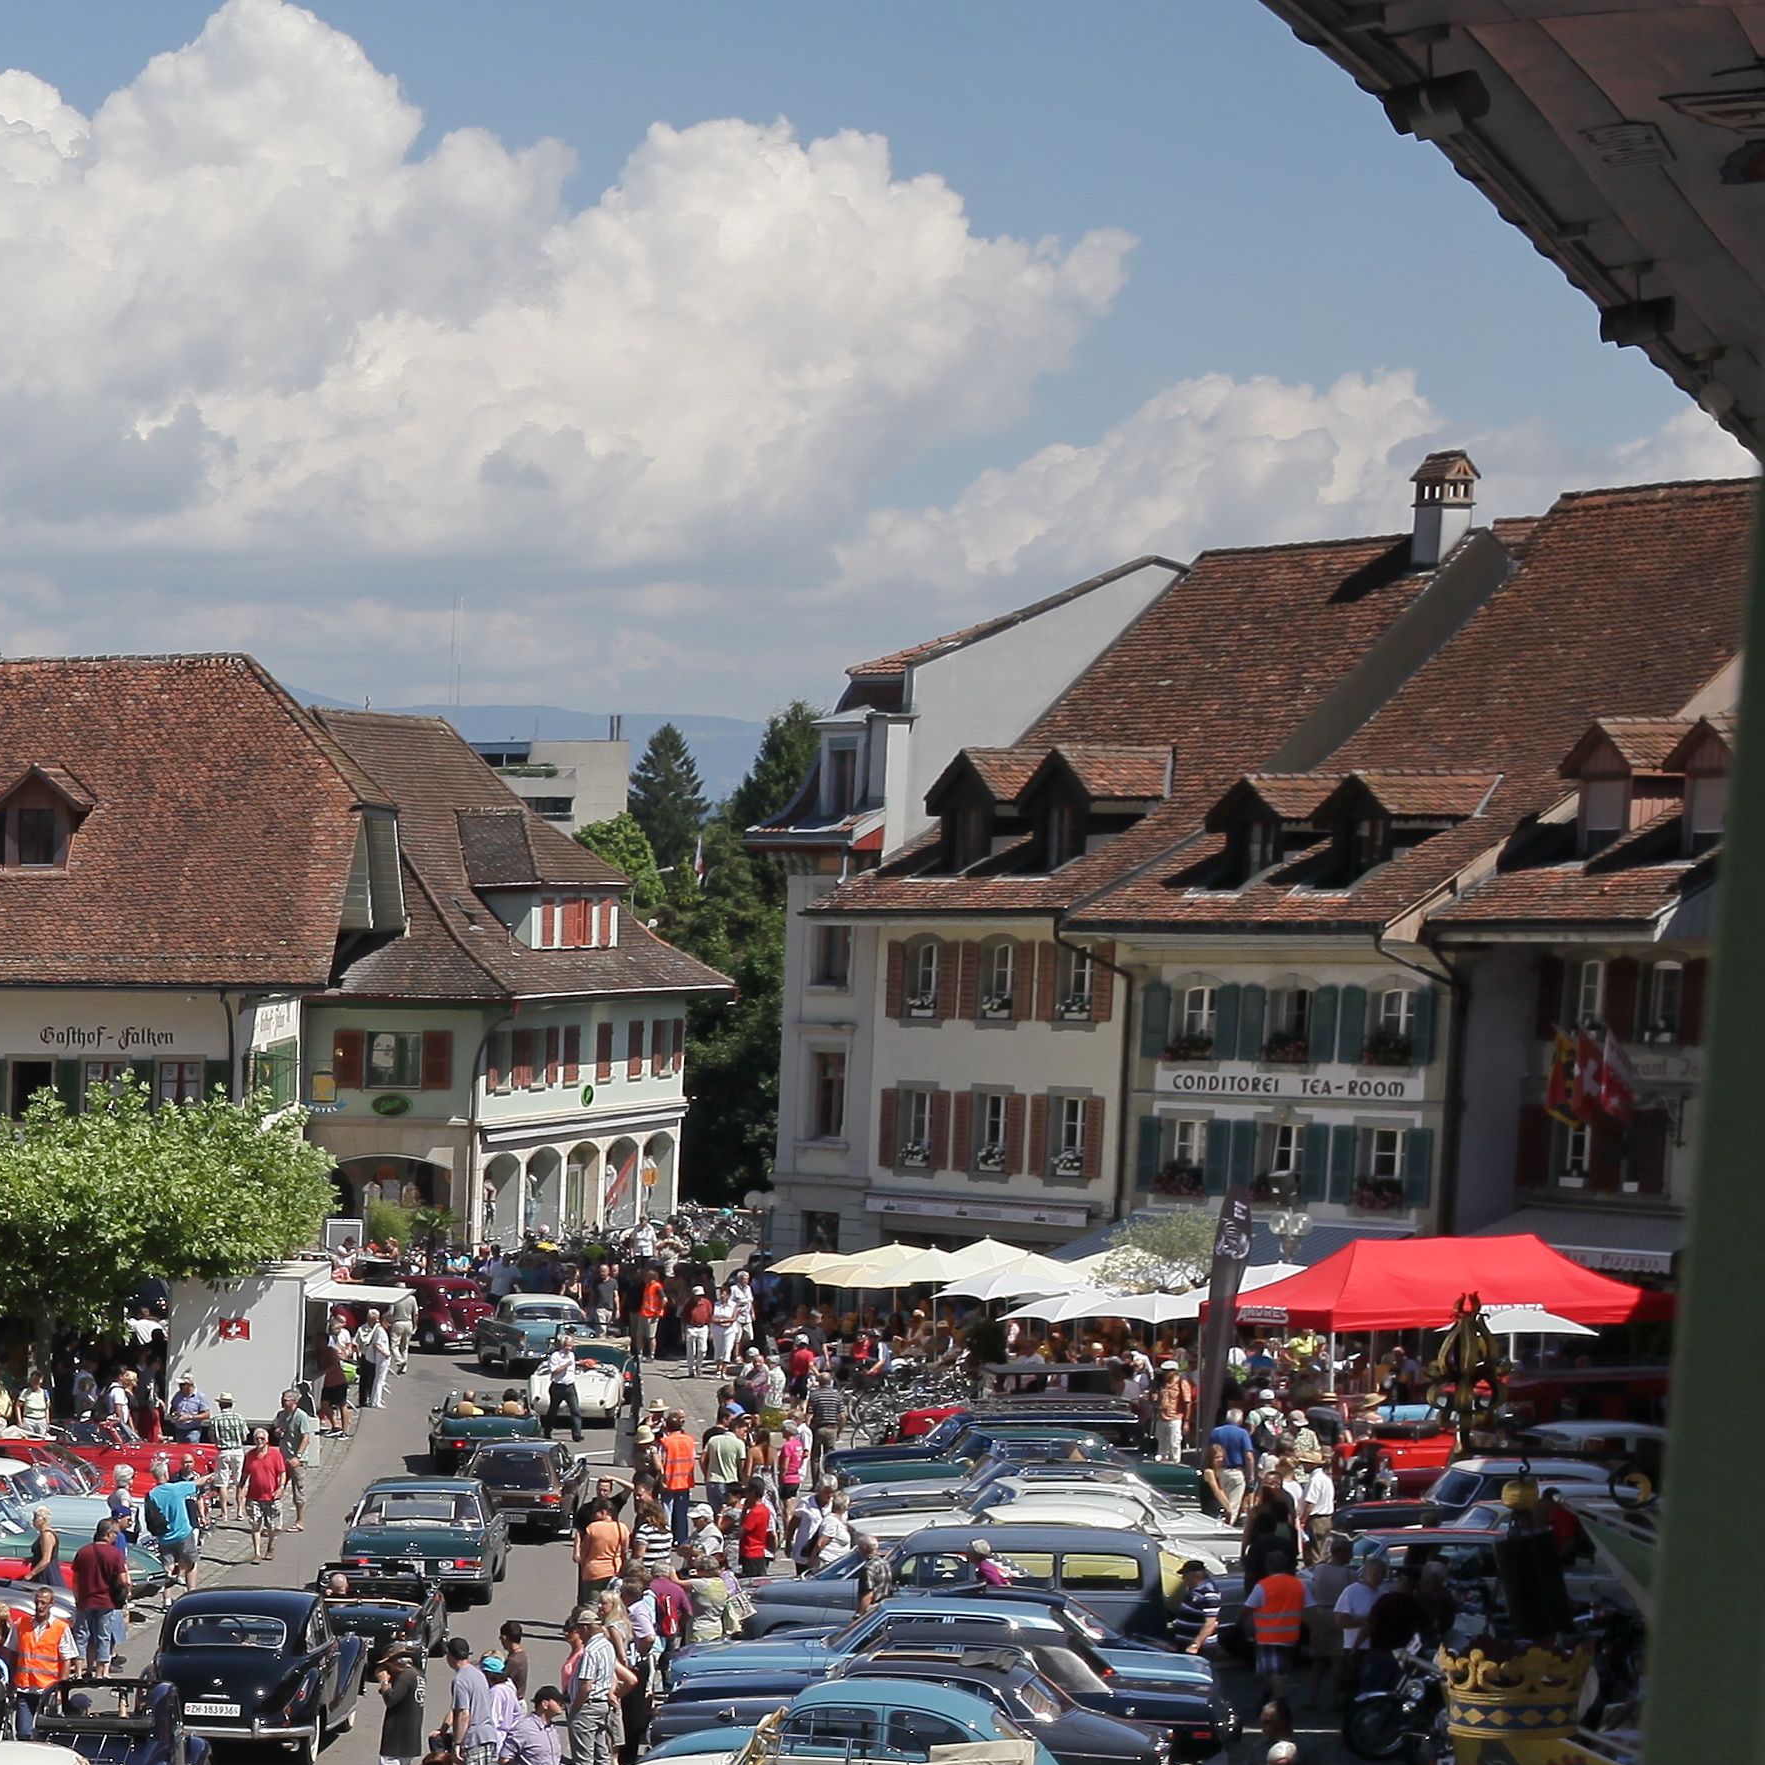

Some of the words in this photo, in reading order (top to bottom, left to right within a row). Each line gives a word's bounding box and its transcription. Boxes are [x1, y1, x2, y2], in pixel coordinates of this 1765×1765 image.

[118, 1025, 174, 1050] Falken
[1172, 1074, 1279, 1093] CONDITOREI
[1301, 1078, 1405, 1097] TEA-ROOM
[1601, 1254, 1659, 1270] PIZZERIA
[1236, 1305, 1288, 1324] ANDRES
